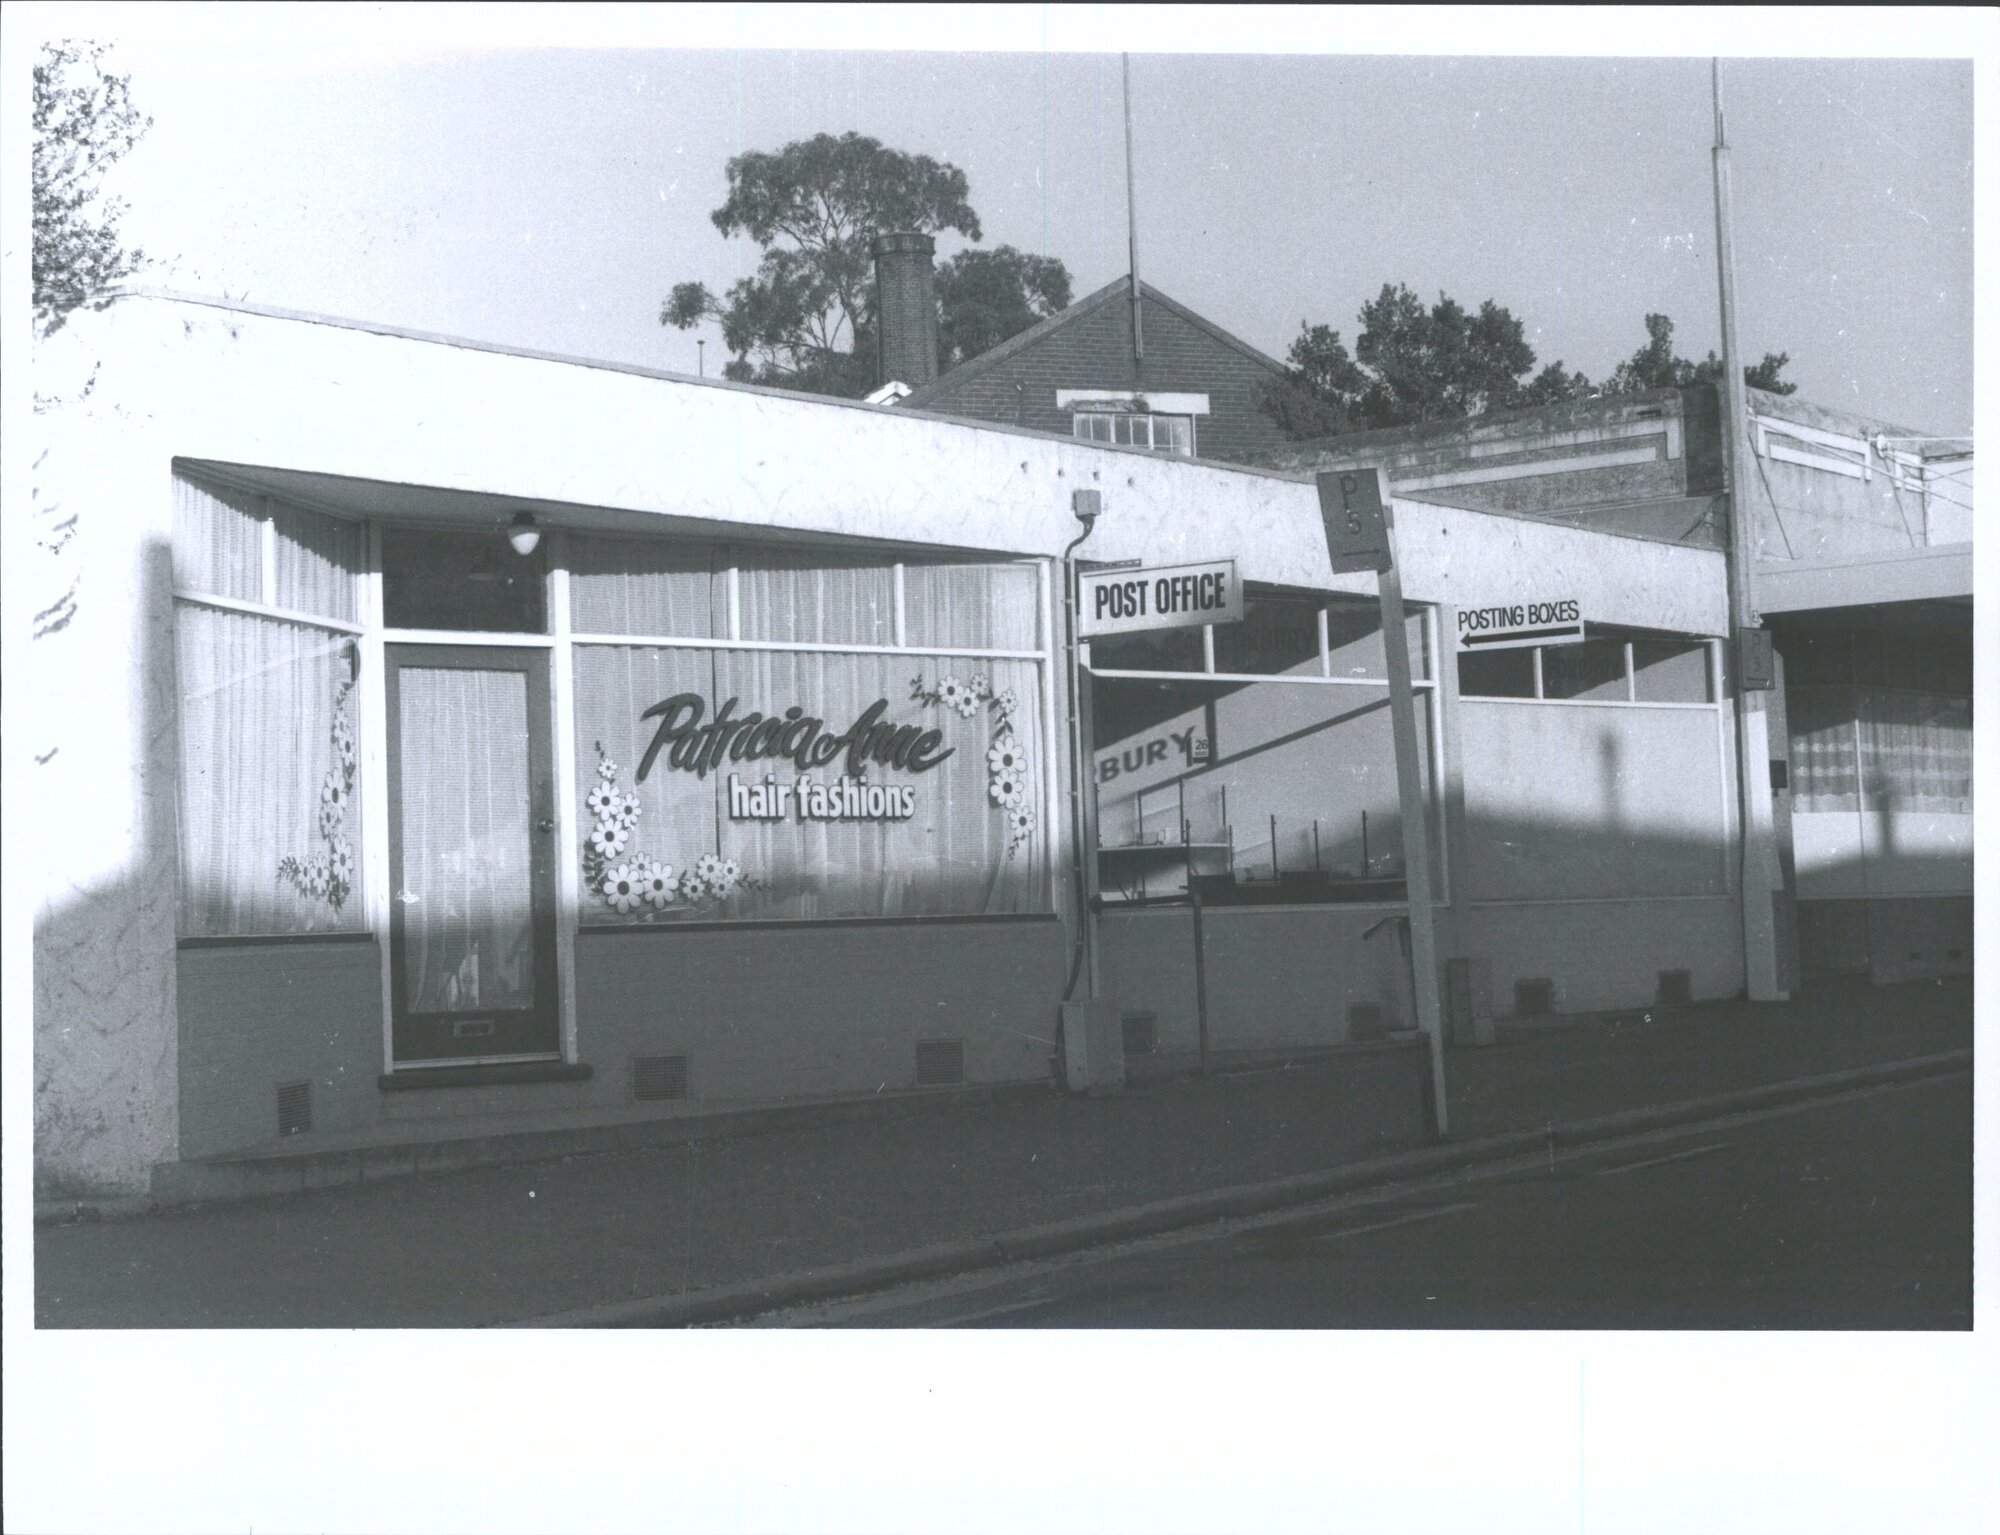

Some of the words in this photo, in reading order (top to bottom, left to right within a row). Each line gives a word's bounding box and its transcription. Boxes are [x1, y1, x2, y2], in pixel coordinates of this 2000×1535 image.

[1341, 475, 1358, 509] P
[1095, 580, 1149, 620] POST
[1155, 572, 1226, 615] OFFICE
[1458, 605, 1525, 632] POSTING
[1528, 600, 1580, 625] BOXES
[636, 693, 823, 782] Patricia
[814, 698, 956, 777] Anne
[1095, 725, 1195, 783] BURY
[1195, 739, 1208, 751] 26
[729, 773, 791, 820] hair
[798, 774, 915, 820] fashions
